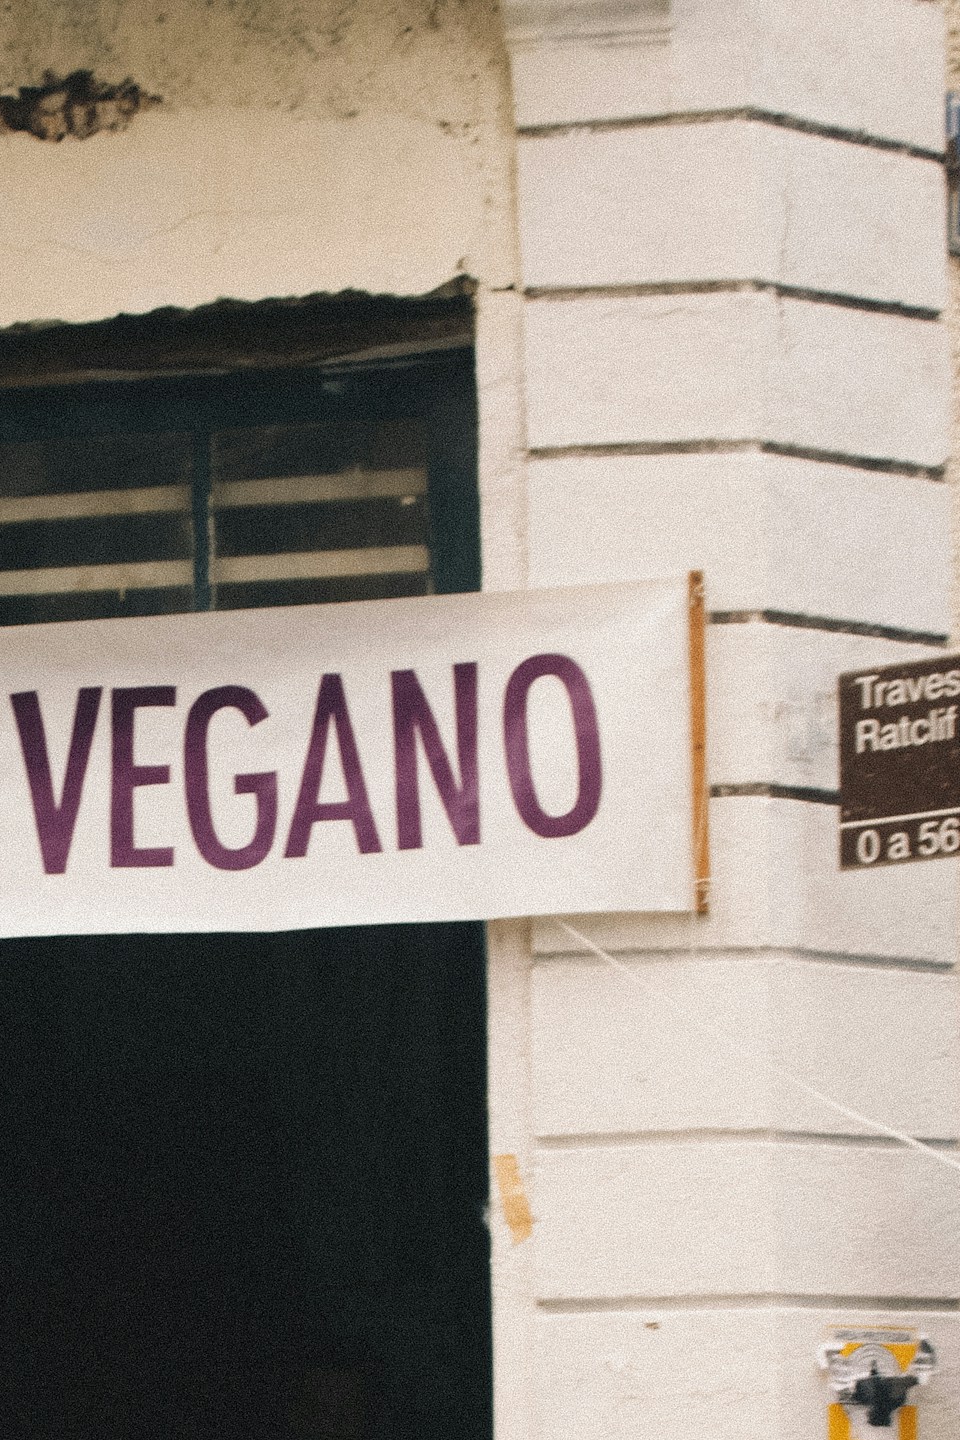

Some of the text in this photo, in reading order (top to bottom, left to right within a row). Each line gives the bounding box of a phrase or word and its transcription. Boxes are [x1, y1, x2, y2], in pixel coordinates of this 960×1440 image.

[9, 651, 604, 875] VEGANO
[856, 819, 960, 863] 0 a 56
